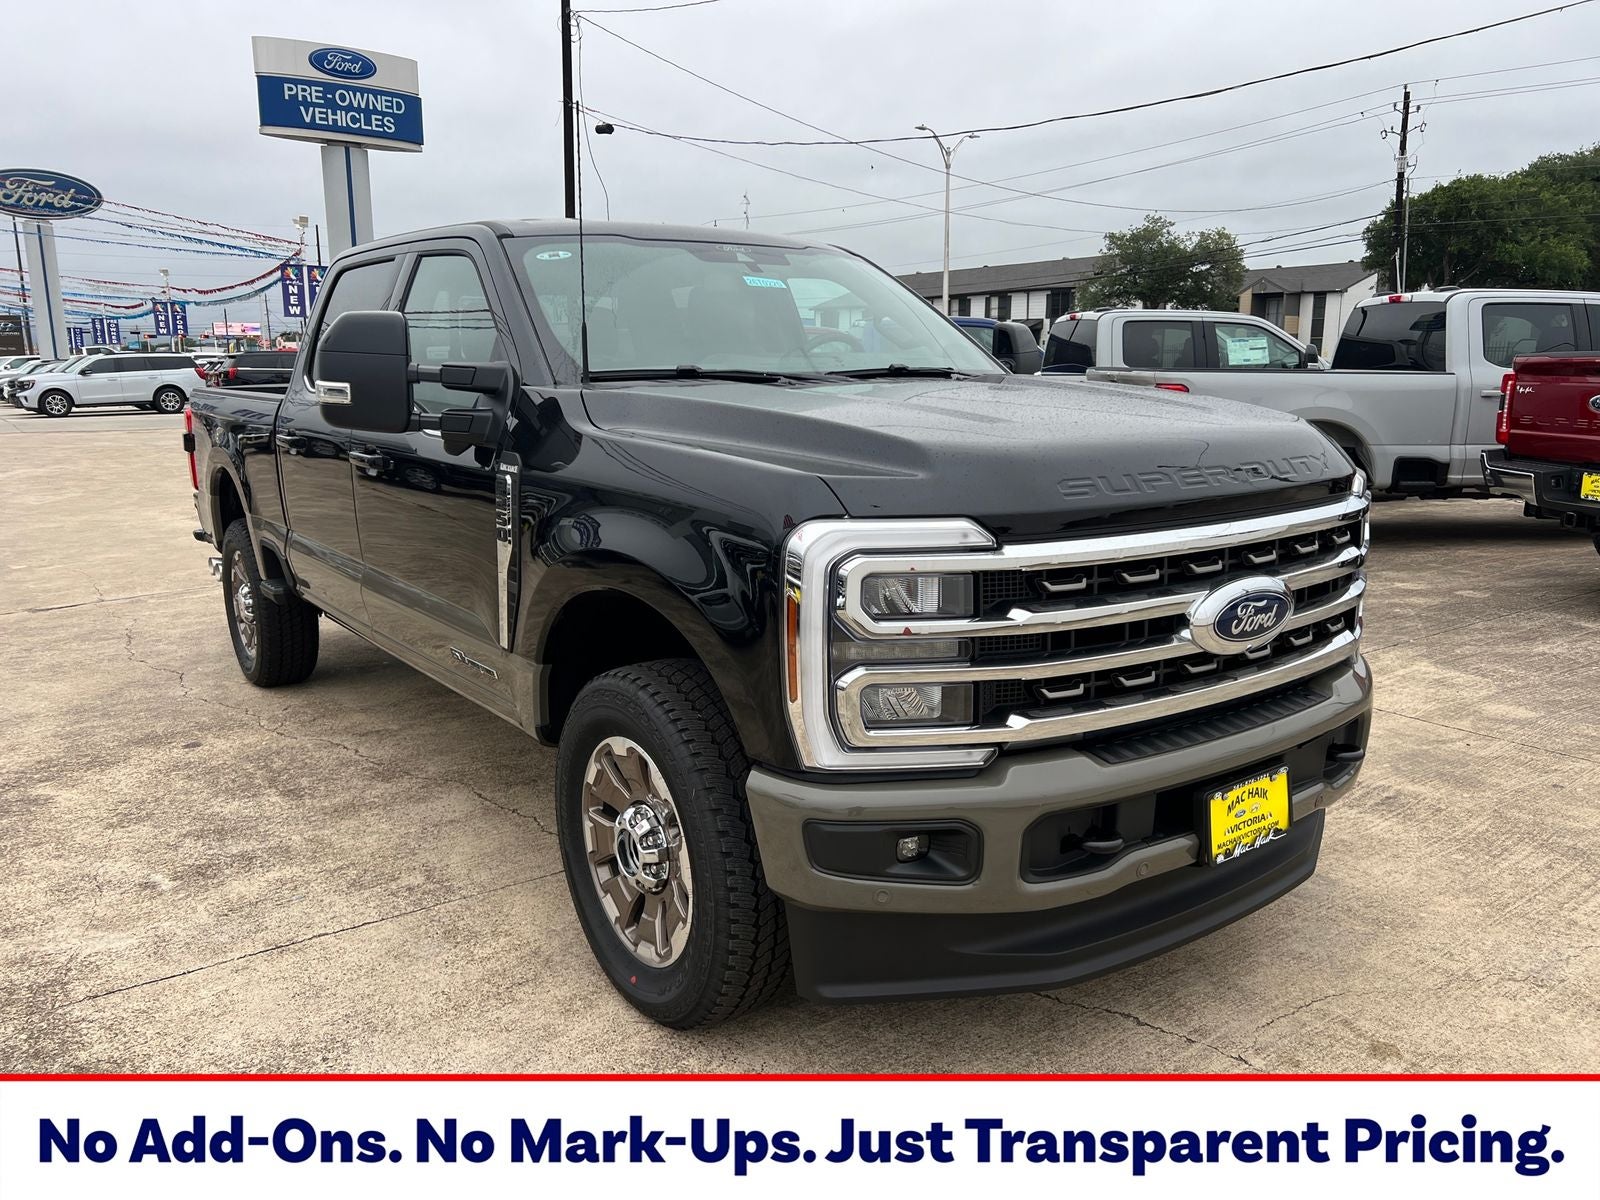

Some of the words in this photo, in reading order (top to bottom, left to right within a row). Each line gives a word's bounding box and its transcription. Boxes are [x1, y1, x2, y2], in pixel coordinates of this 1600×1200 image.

[323, 52, 363, 74] Ford
[283, 83, 406, 114] PRE-OWNED
[299, 106, 396, 133] VEHICLES
[0, 177, 76, 208] Ford
[288, 285, 301, 315] NEW
[158, 315, 168, 334] NEW
[176, 315, 184, 335] FORD
[1057, 463, 1241, 500] SUPER
[1239, 451, 1331, 482] DUTY
[1231, 599, 1279, 635] Ford
[1227, 790, 1246, 817] MAC
[1247, 786, 1269, 801] HAIK
[1229, 813, 1267, 834] VICTORIA
[1233, 840, 1253, 858] Mac
